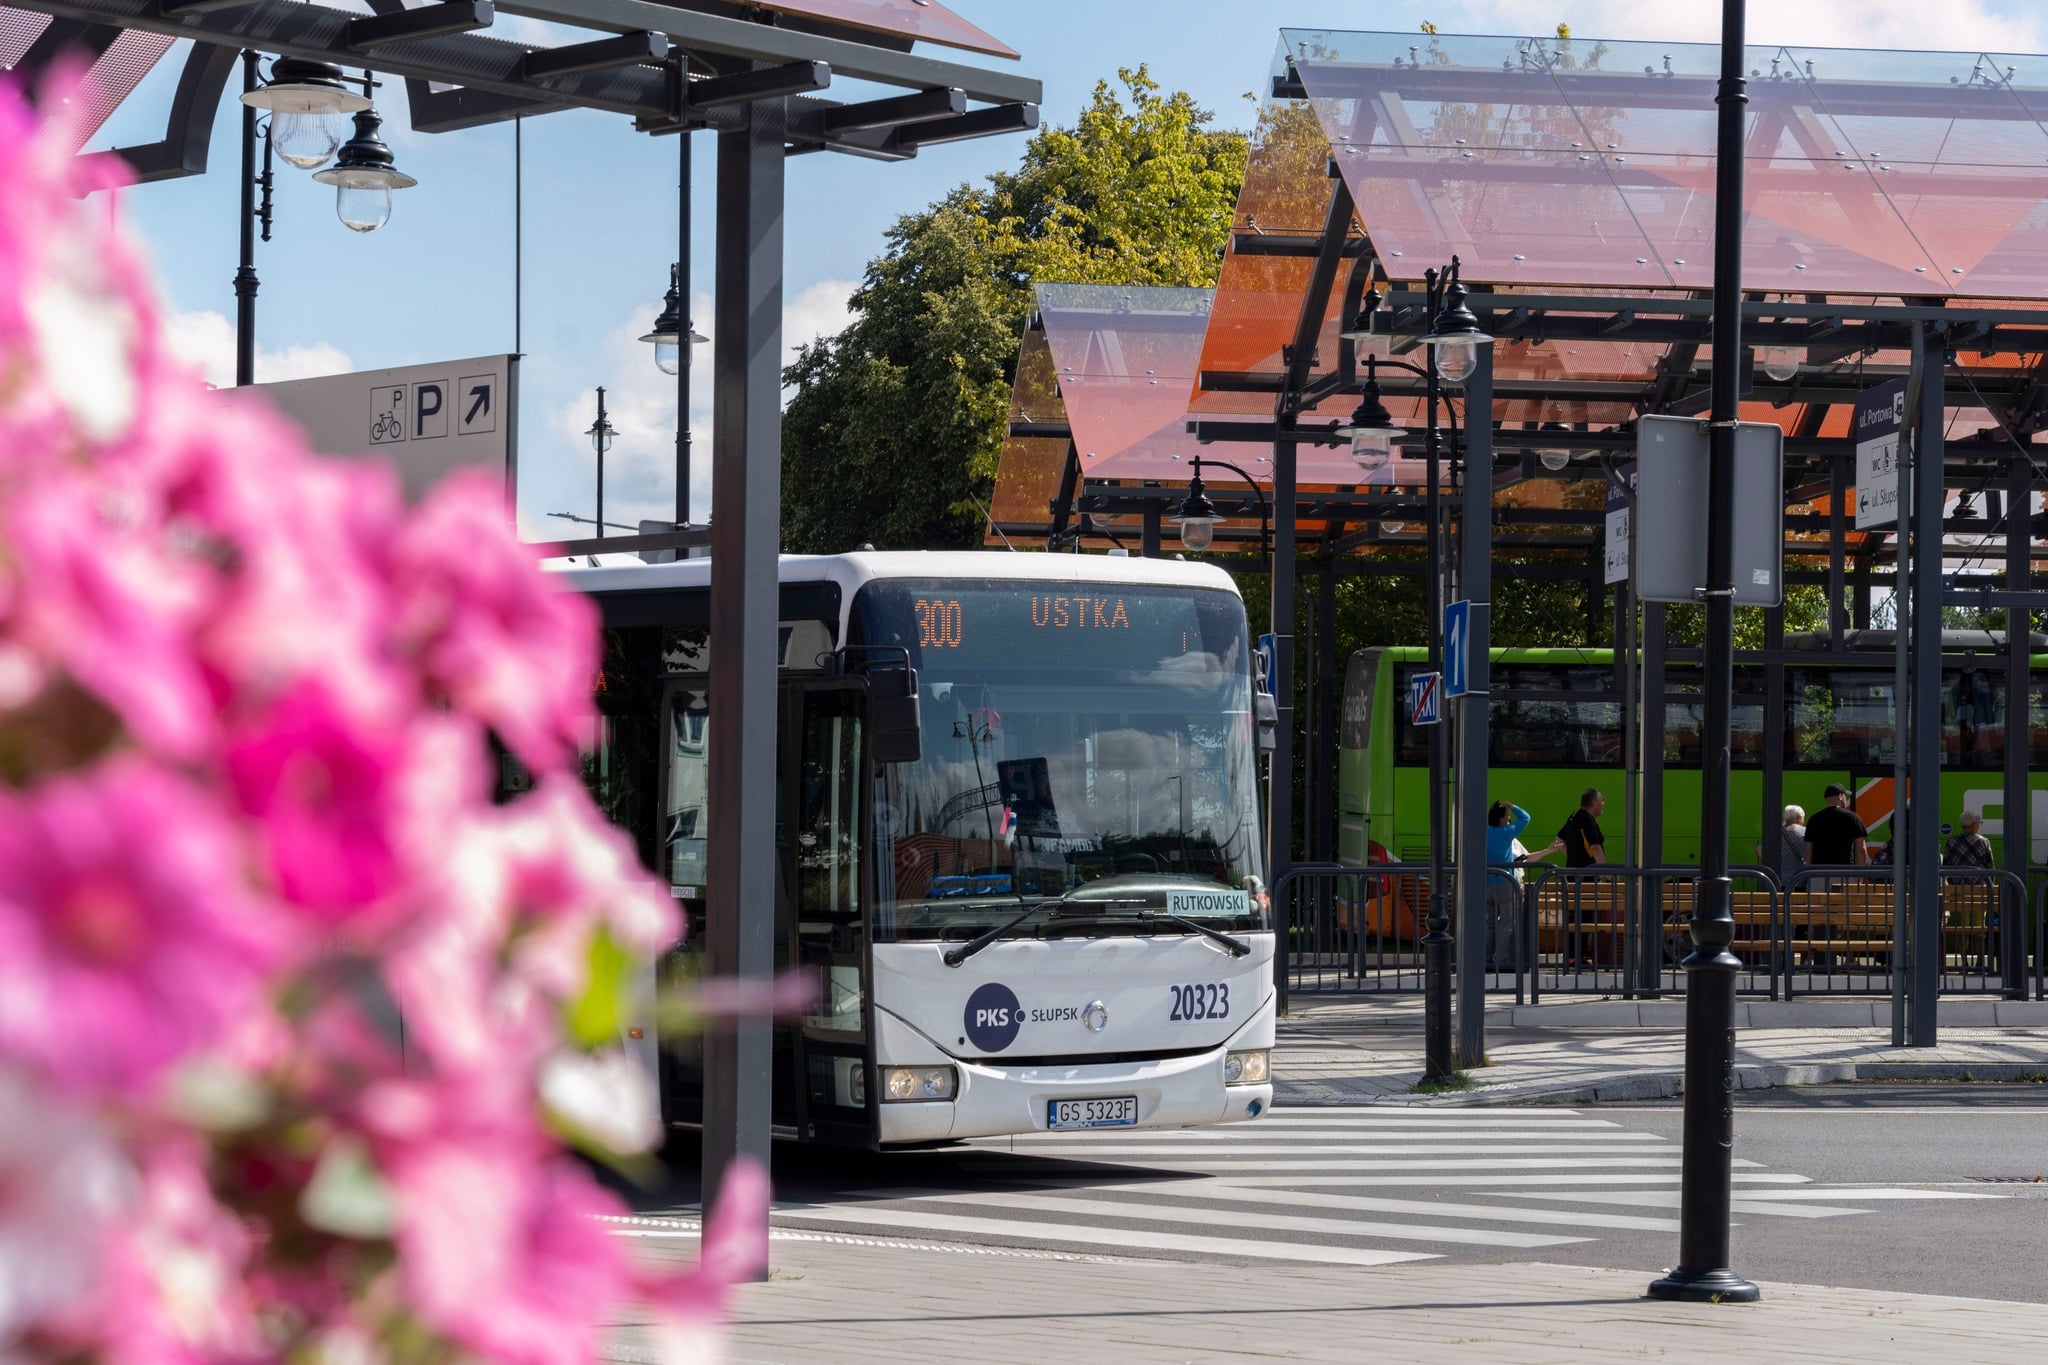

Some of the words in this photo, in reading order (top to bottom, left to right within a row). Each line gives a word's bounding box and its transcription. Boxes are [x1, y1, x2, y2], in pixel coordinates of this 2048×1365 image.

[417, 385, 442, 436] P
[1868, 406, 1893, 426] Portowa
[1872, 458, 1881, 471] WC
[1880, 485, 1898, 508] Słups
[915, 600, 961, 647] 300
[1032, 597, 1129, 628] USTKA
[1451, 614, 1460, 687] 1
[1412, 681, 1436, 717] TAXI
[1173, 895, 1244, 911] RUTKOWSKI
[1169, 983, 1230, 1021] 20323
[976, 1008, 1009, 1028] PKS
[1031, 1007, 1078, 1022] SŁUPSK
[1060, 1103, 1080, 1121] GS
[1086, 1100, 1133, 1120] 5323F
